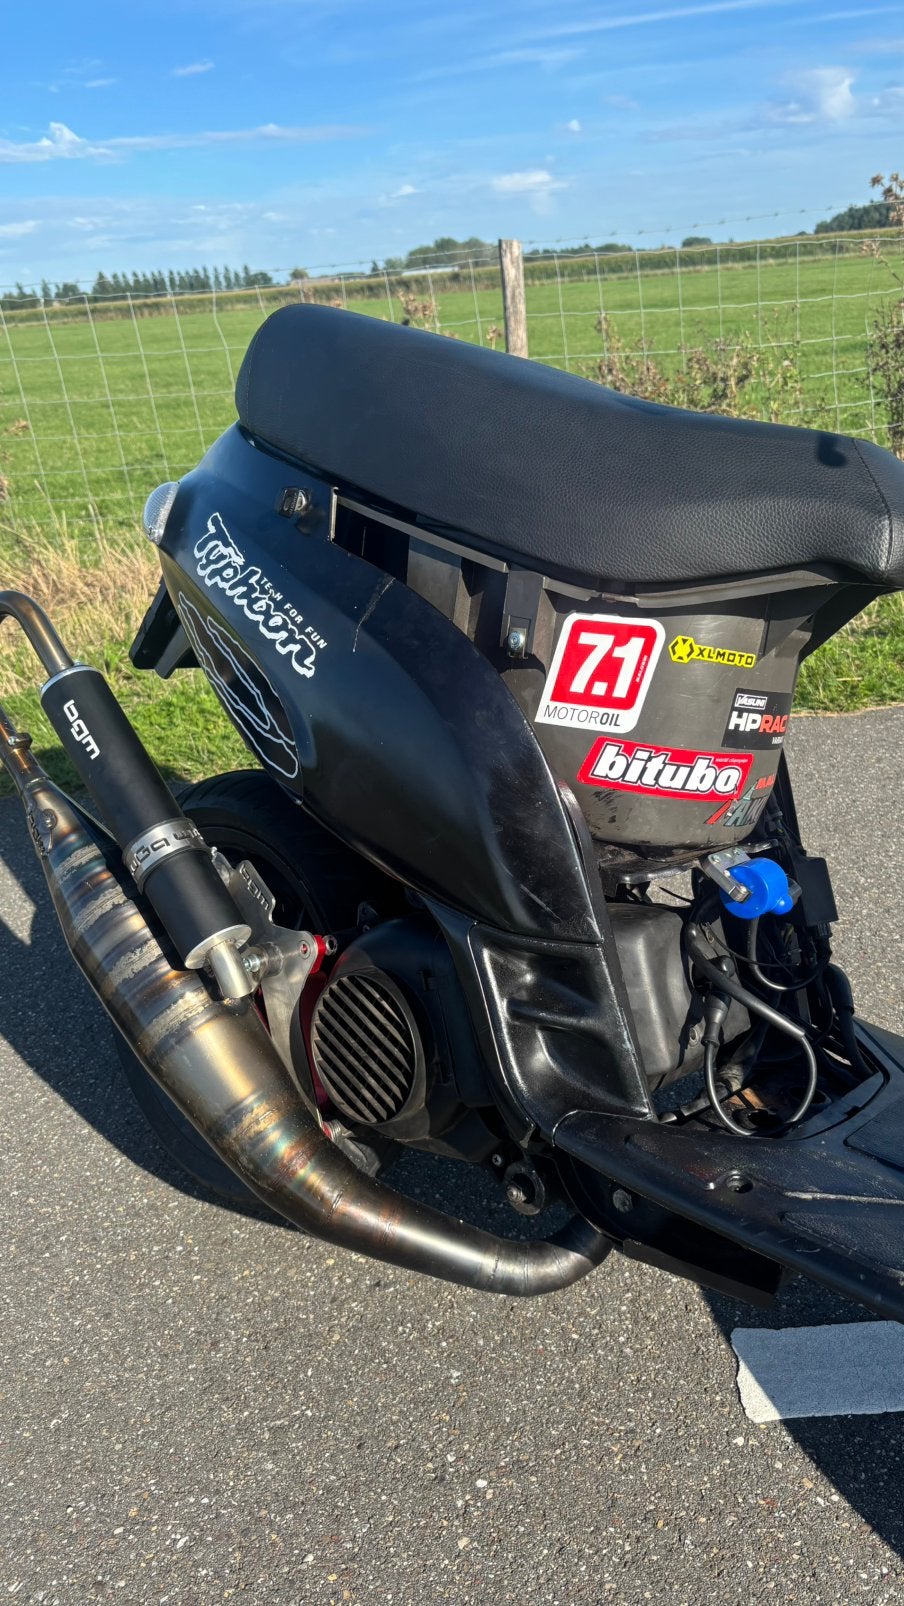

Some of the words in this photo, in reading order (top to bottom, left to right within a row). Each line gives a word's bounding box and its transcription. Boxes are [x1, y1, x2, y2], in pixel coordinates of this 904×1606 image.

[283, 603, 304, 625] FOR
[304, 626, 328, 650] FUN
[569, 631, 646, 699] 7.1
[697, 646, 755, 666] XLMOTO
[736, 694, 767, 708] YASUNI
[63, 699, 101, 761] bgm
[590, 742, 742, 795] bitubo
